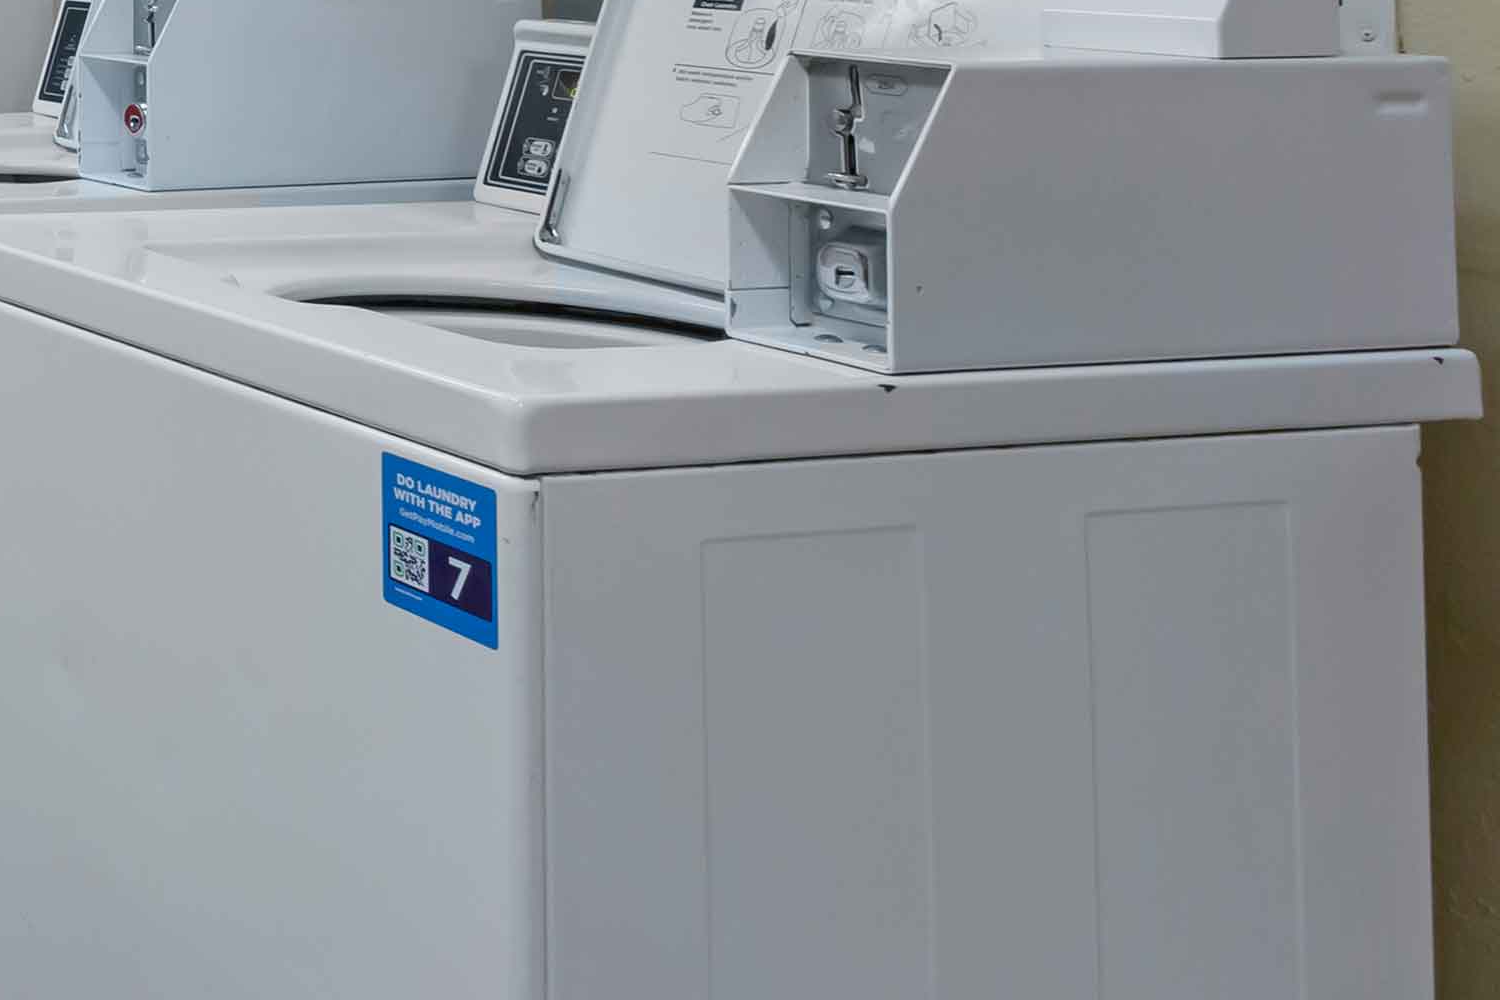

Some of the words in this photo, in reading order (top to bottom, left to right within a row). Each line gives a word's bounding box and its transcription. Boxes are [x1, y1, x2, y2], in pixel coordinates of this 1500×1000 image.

[393, 486, 425, 510] WITH
[428, 499, 453, 520] THE
[455, 511, 481, 528] APP
[396, 472, 414, 489] DO
[417, 480, 477, 512] LAUNDRY
[448, 556, 472, 600] 7
